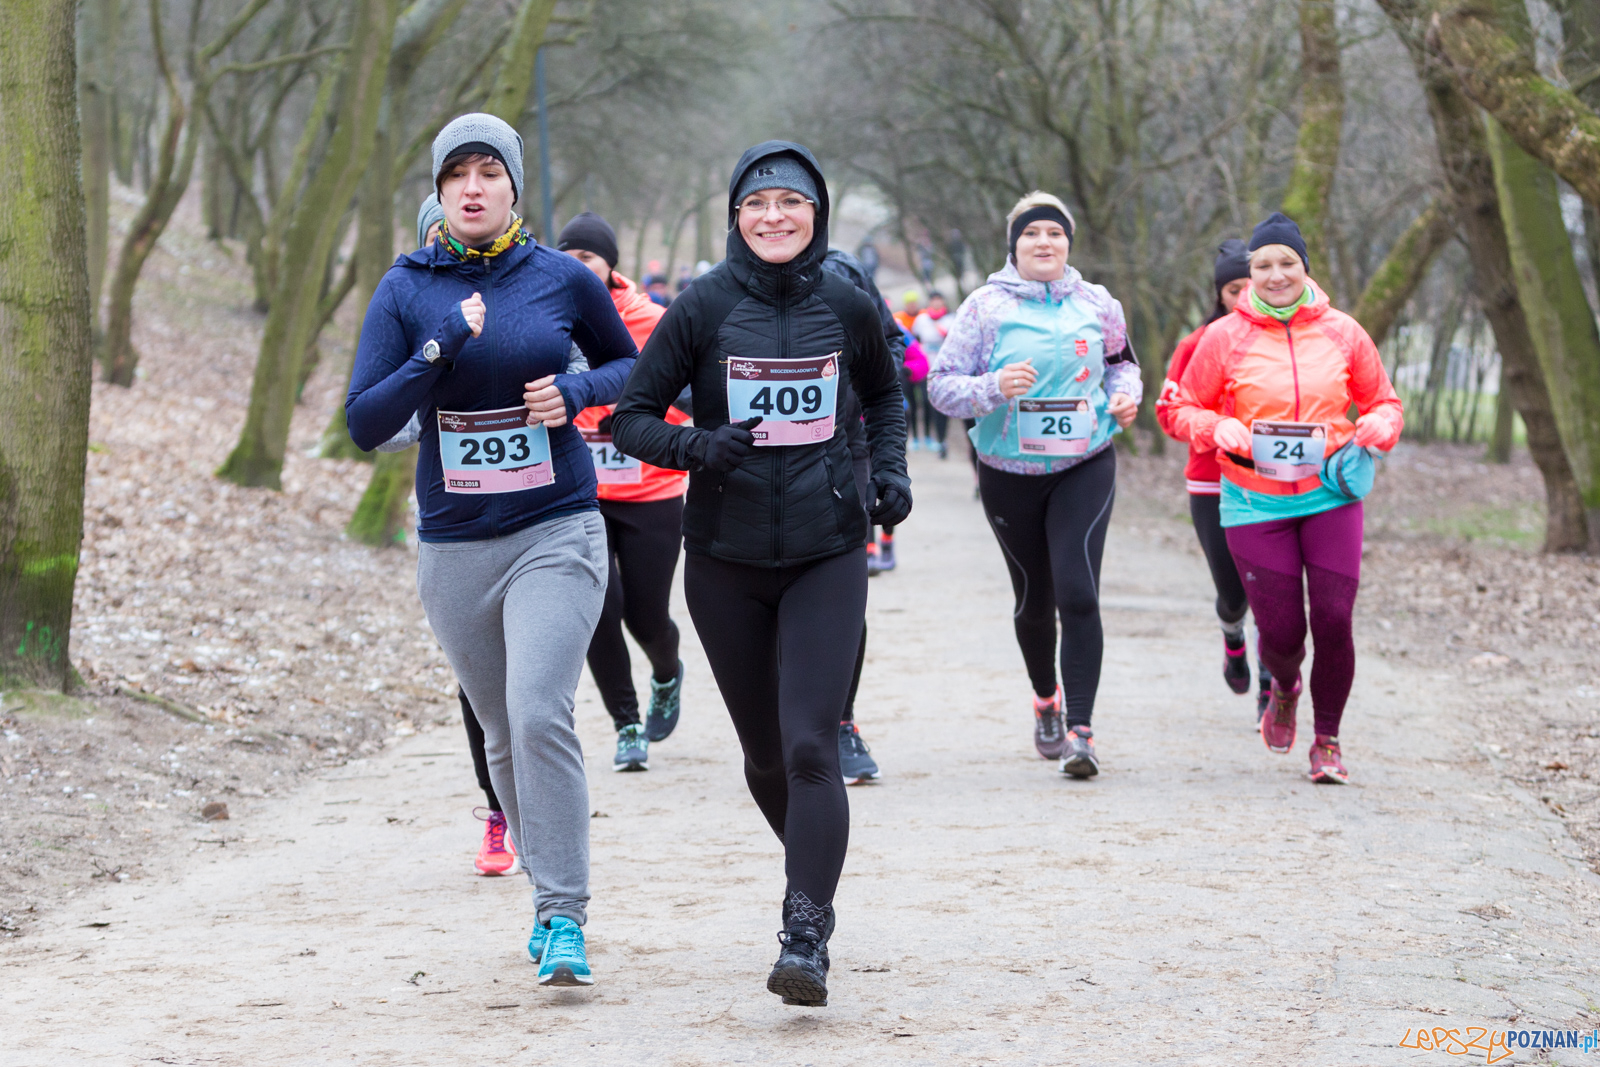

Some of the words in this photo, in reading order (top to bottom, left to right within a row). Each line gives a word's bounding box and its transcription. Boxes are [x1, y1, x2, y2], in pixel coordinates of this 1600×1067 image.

[749, 385, 822, 416] 409
[1041, 415, 1072, 435] 26
[459, 433, 531, 465] 293
[588, 446, 627, 465] 14
[1273, 440, 1305, 460] 24
